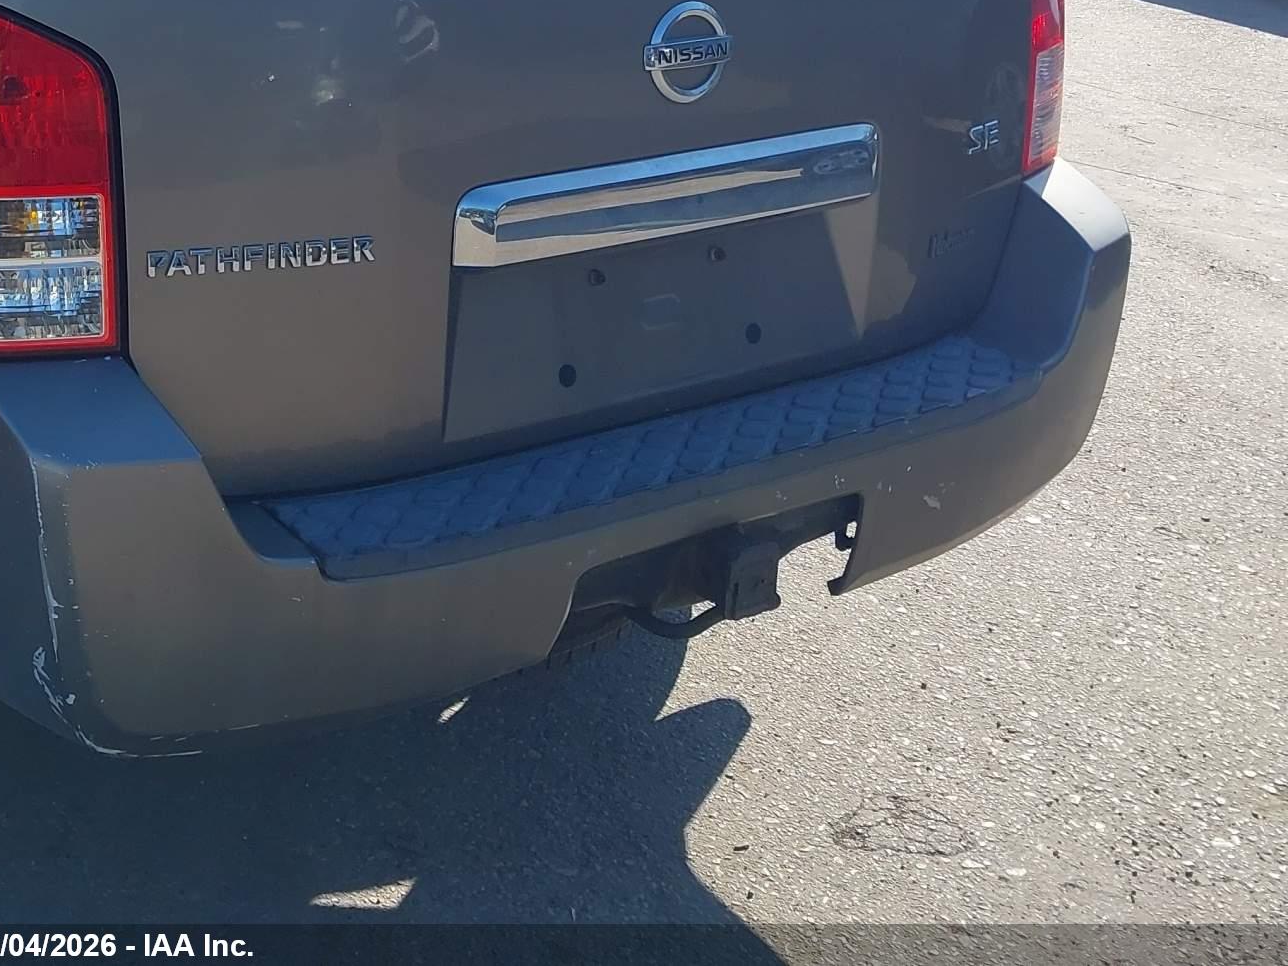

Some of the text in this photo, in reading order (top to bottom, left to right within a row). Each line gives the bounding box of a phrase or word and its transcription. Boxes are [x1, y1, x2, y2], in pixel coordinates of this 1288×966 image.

[657, 41, 729, 66] NISSAN
[967, 118, 1000, 156] SE
[146, 235, 376, 278] PATHFINDER
